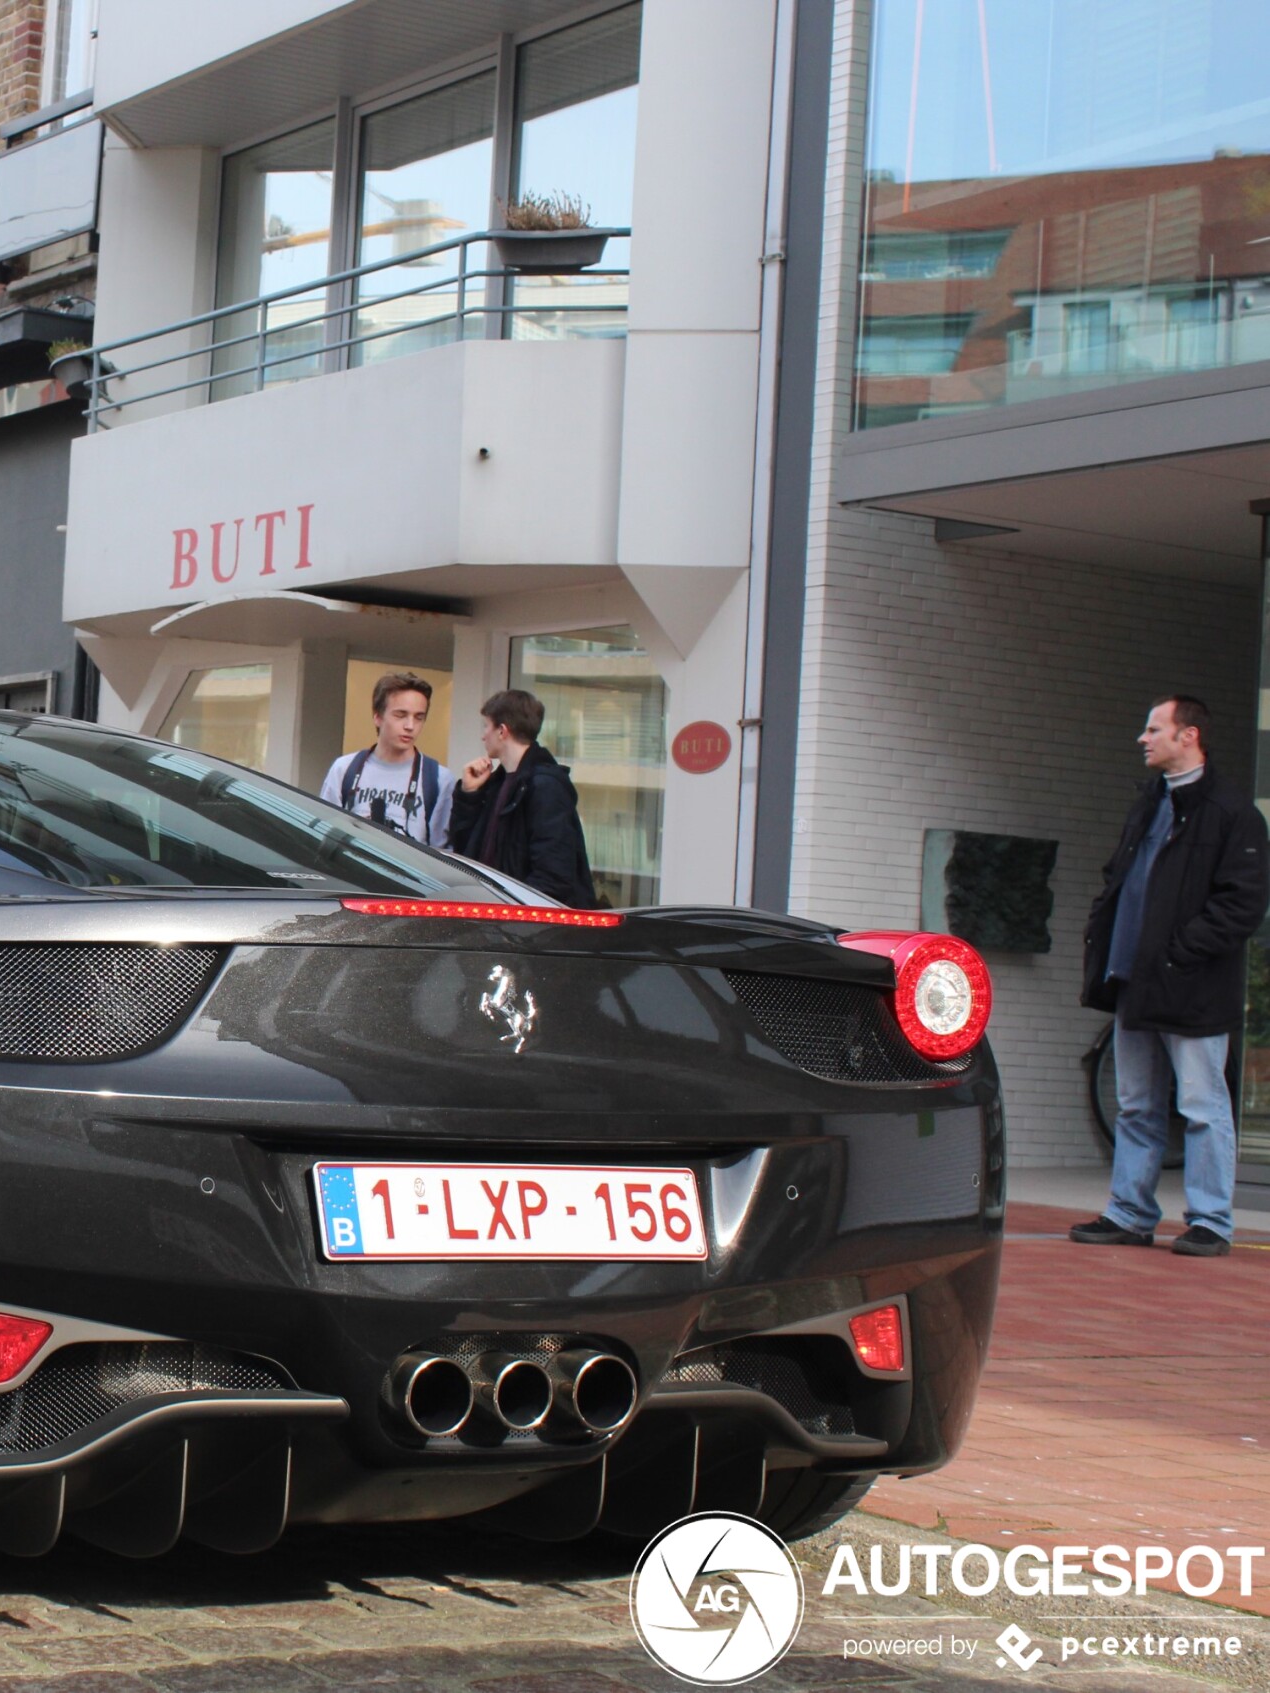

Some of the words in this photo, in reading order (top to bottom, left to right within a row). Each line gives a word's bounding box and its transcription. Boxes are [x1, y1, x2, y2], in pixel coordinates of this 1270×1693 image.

[169, 503, 315, 590] BUTI
[681, 737, 722, 755] BUTI
[332, 1217, 357, 1248] B
[371, 1179, 693, 1243] 1-LXP-156
